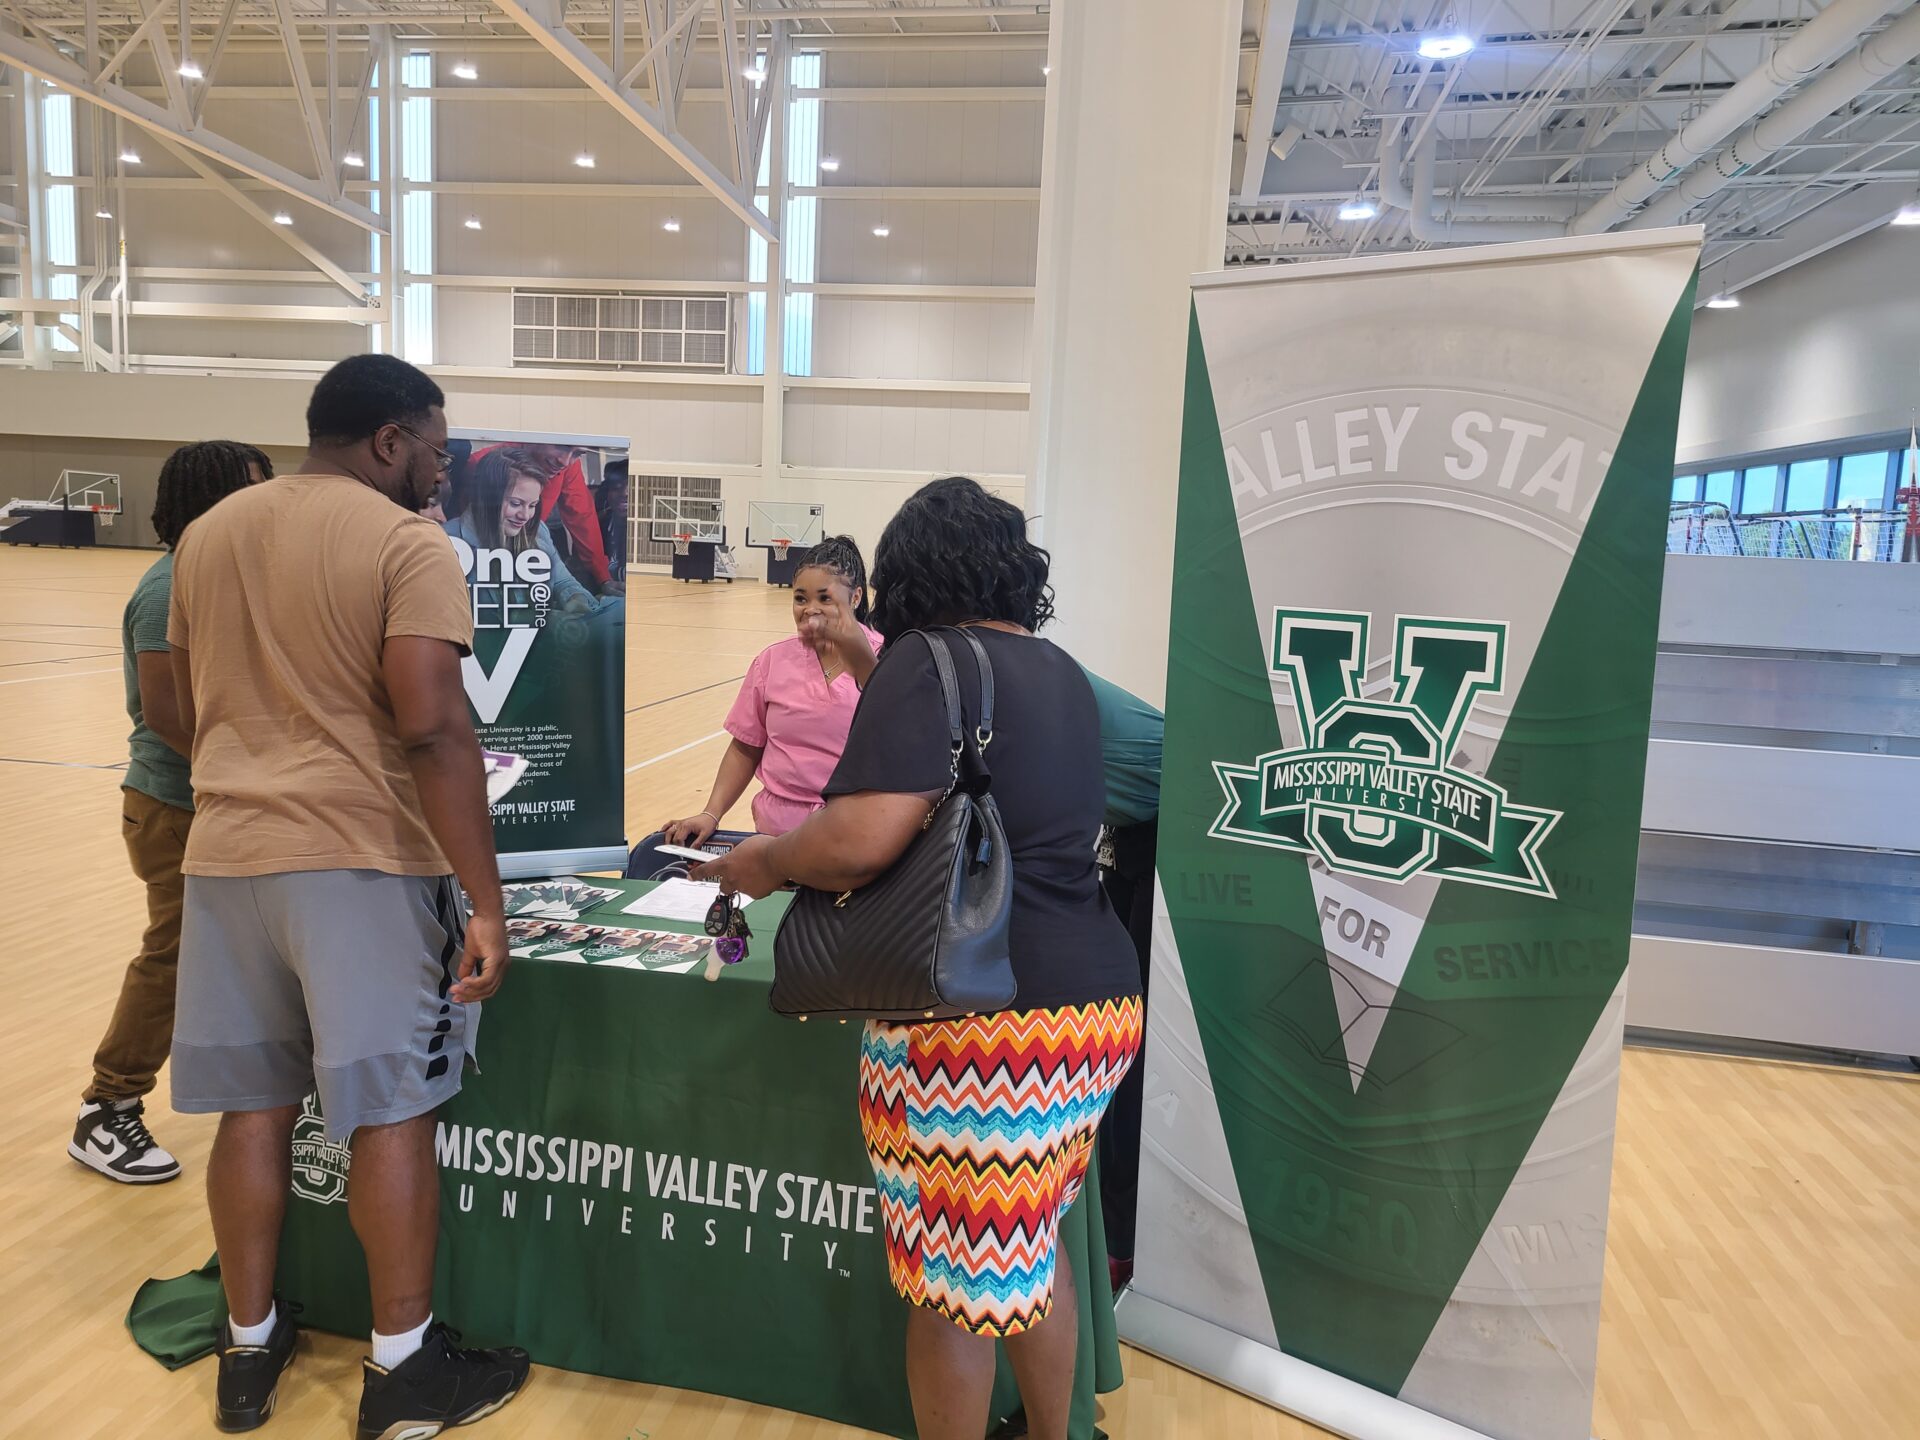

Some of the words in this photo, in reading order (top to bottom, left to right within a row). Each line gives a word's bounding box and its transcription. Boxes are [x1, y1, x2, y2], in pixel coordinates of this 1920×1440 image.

[467, 583, 530, 629] EE
[460, 628, 540, 724] V
[489, 726, 523, 734] University
[537, 724, 559, 733] public,
[517, 743, 551, 751] Mississippi
[551, 742, 571, 750] Valley
[517, 801, 549, 814] VALLEY
[550, 799, 576, 812] STATE
[1273, 760, 1365, 791] MISSISSIPPI
[1369, 764, 1428, 800] VALLEY
[1431, 778, 1483, 822] STATE
[1295, 786, 1460, 829] UNIVERSITY
[1180, 870, 1252, 907] LIVE
[1319, 895, 1391, 959] FOR
[1432, 936, 1618, 983] SERVICE
[316, 1146, 340, 1165] VALLEY
[435, 1120, 633, 1193] MISSISSIPPI
[645, 1150, 768, 1213] VALLEY
[775, 1172, 876, 1235] STATE
[459, 1183, 838, 1270] UNIVERSITY
[1263, 1154, 1418, 1270] 1950
